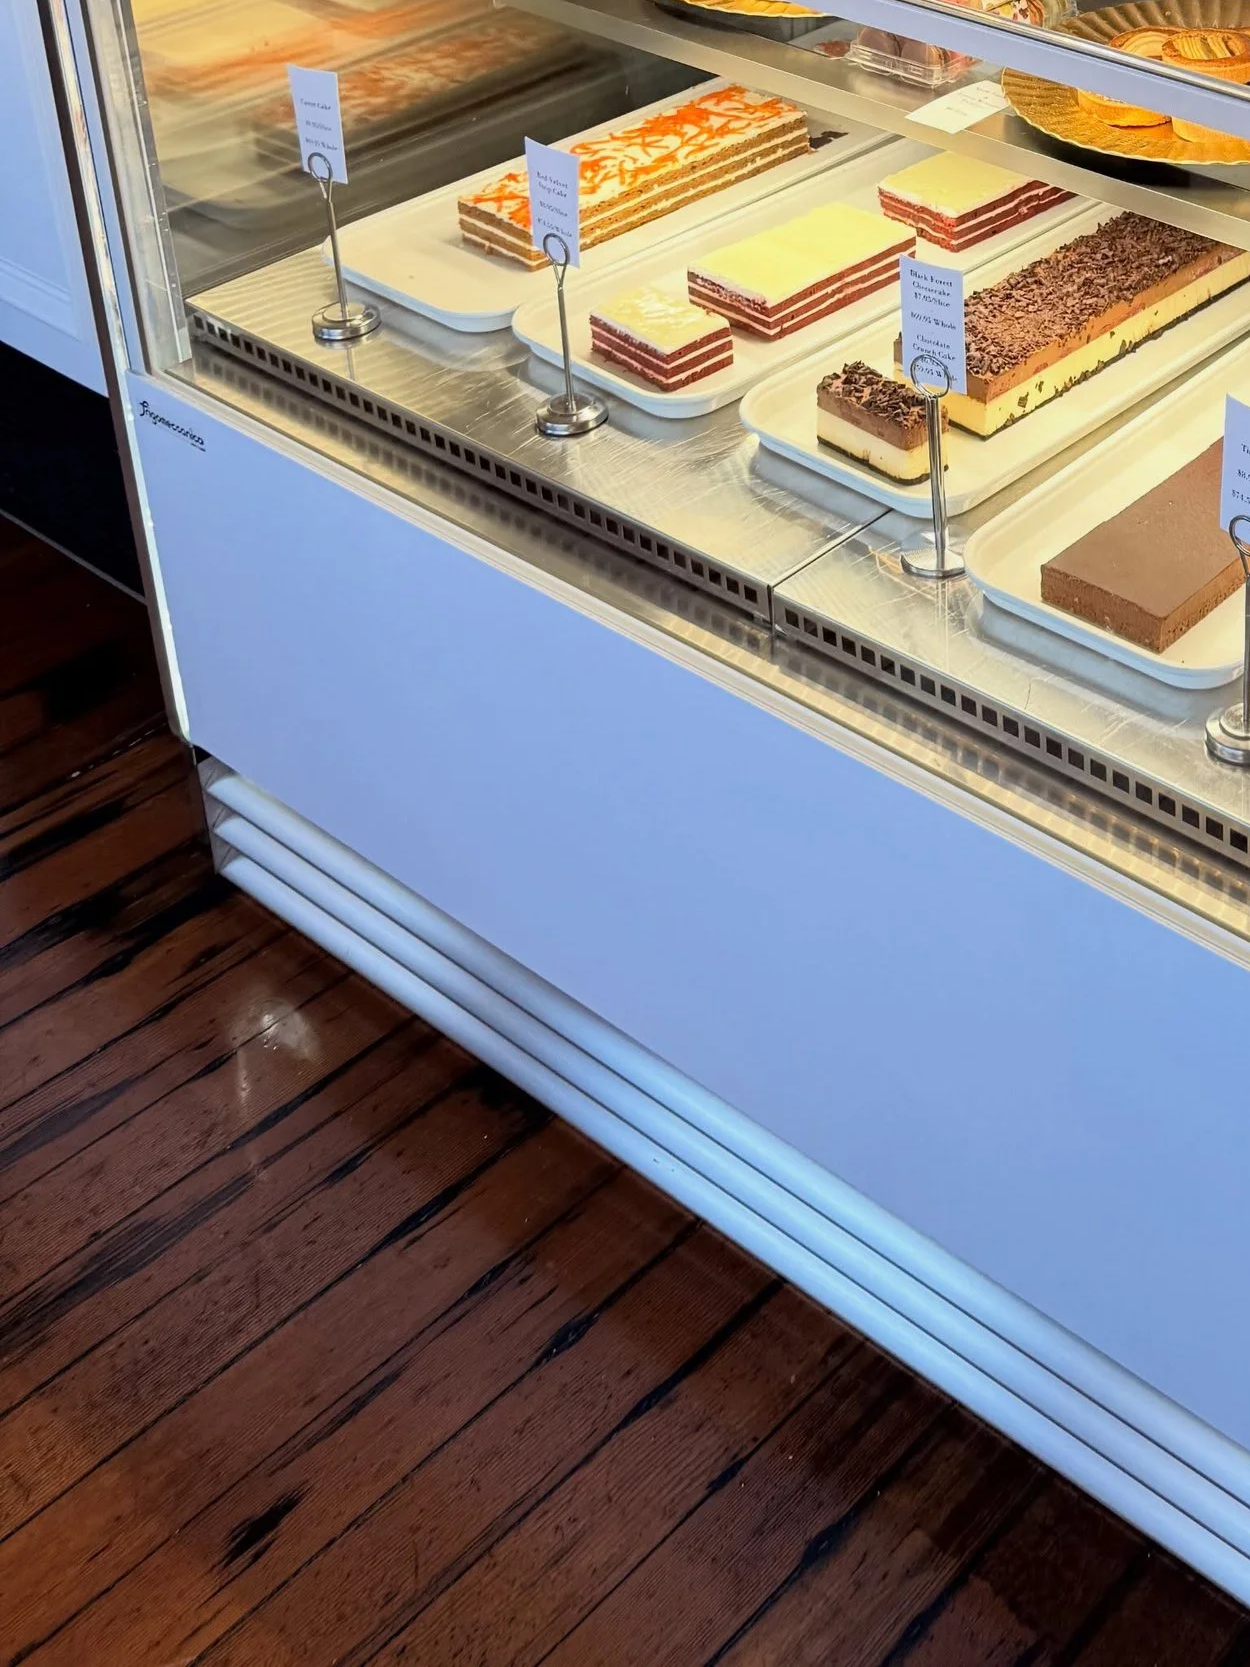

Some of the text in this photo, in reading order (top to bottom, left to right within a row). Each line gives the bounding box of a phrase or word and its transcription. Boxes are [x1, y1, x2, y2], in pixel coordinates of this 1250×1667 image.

[910, 269, 953, 288] Black Forest
[912, 280, 951, 297] Cheesecake
[933, 318, 957, 331] Whole
[916, 333, 951, 349] Chocolate
